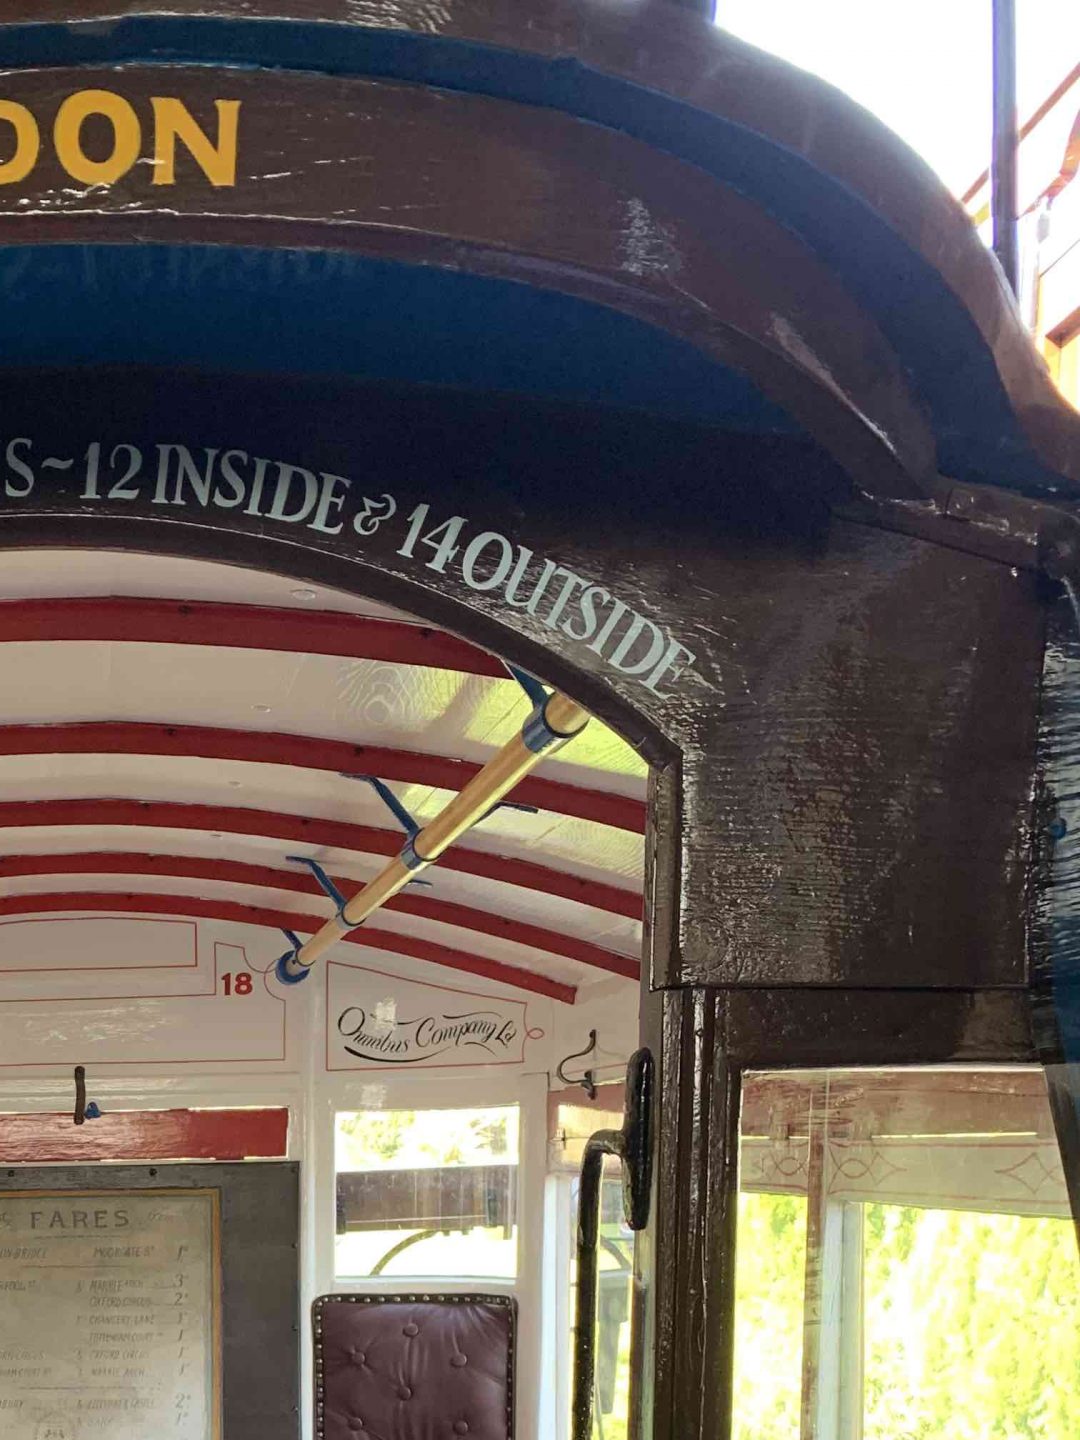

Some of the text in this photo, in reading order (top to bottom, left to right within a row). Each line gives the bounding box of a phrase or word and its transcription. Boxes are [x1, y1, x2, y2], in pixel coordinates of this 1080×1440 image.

[152, 443, 352, 535] INSIDE
[353, 493, 397, 536] &
[395, 502, 469, 574] 14
[462, 529, 697, 700] OUTSIDE
[220, 972, 254, 996] 18
[338, 1006, 411, 1053] Omnibus
[415, 1016, 497, 1049] Company
[29, 1209, 131, 1230] FARES
